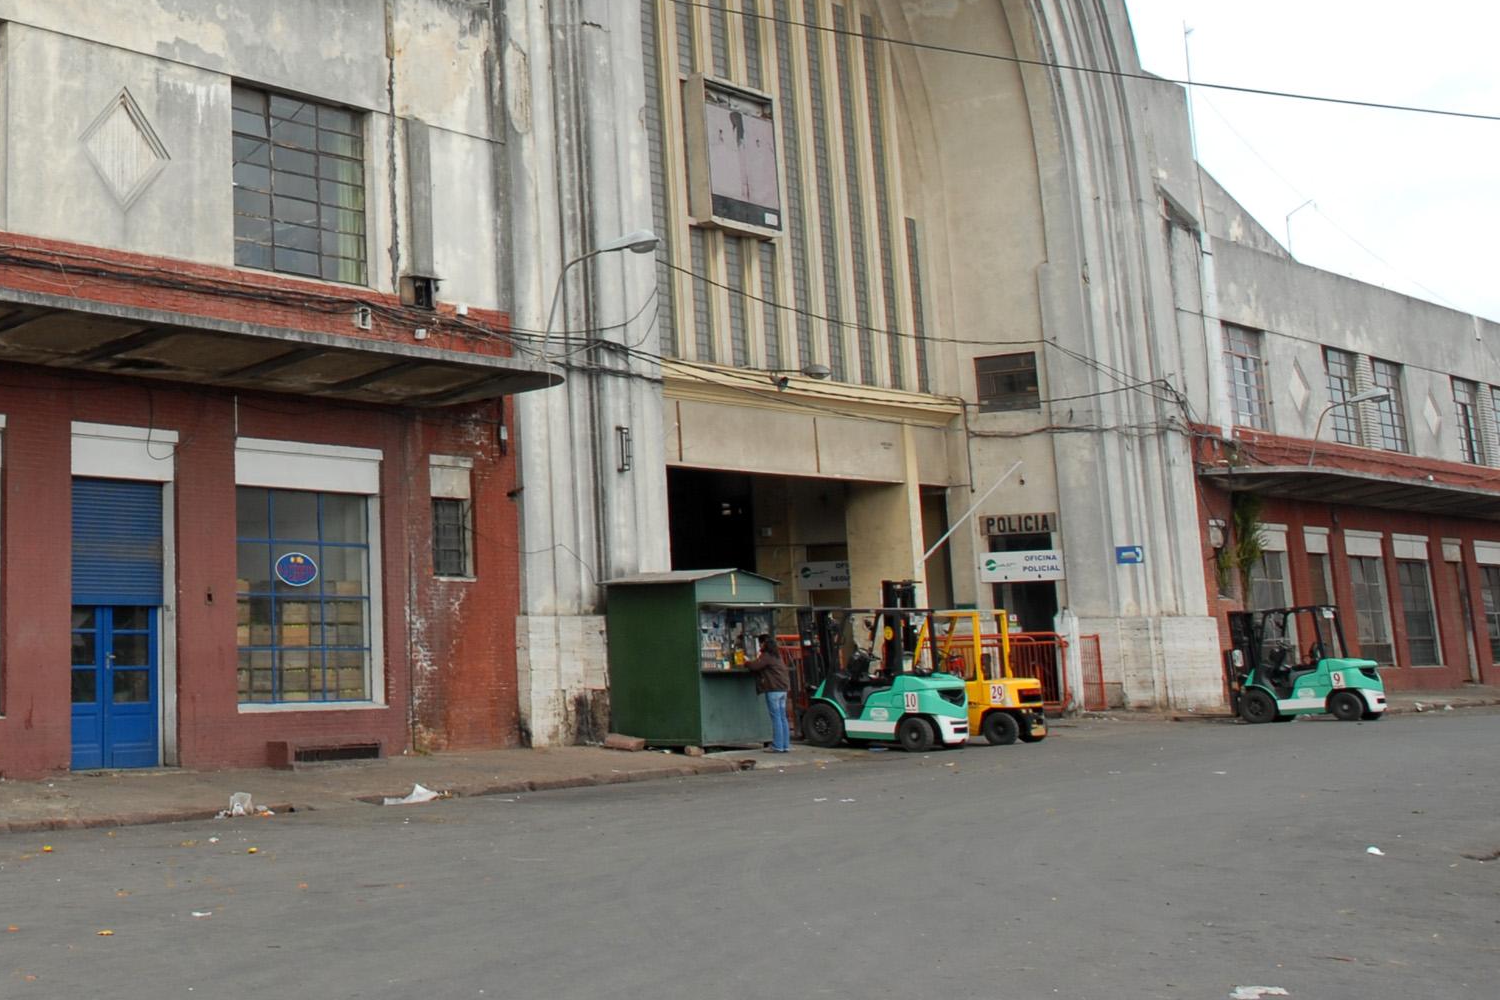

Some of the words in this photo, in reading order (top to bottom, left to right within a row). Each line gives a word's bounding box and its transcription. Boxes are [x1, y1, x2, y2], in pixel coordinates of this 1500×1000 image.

[987, 514, 1050, 533] POLICIA
[1025, 554, 1057, 562] OFICINA
[1333, 672, 1341, 684] 9
[991, 685, 1003, 699] 29
[905, 693, 917, 708] 10
